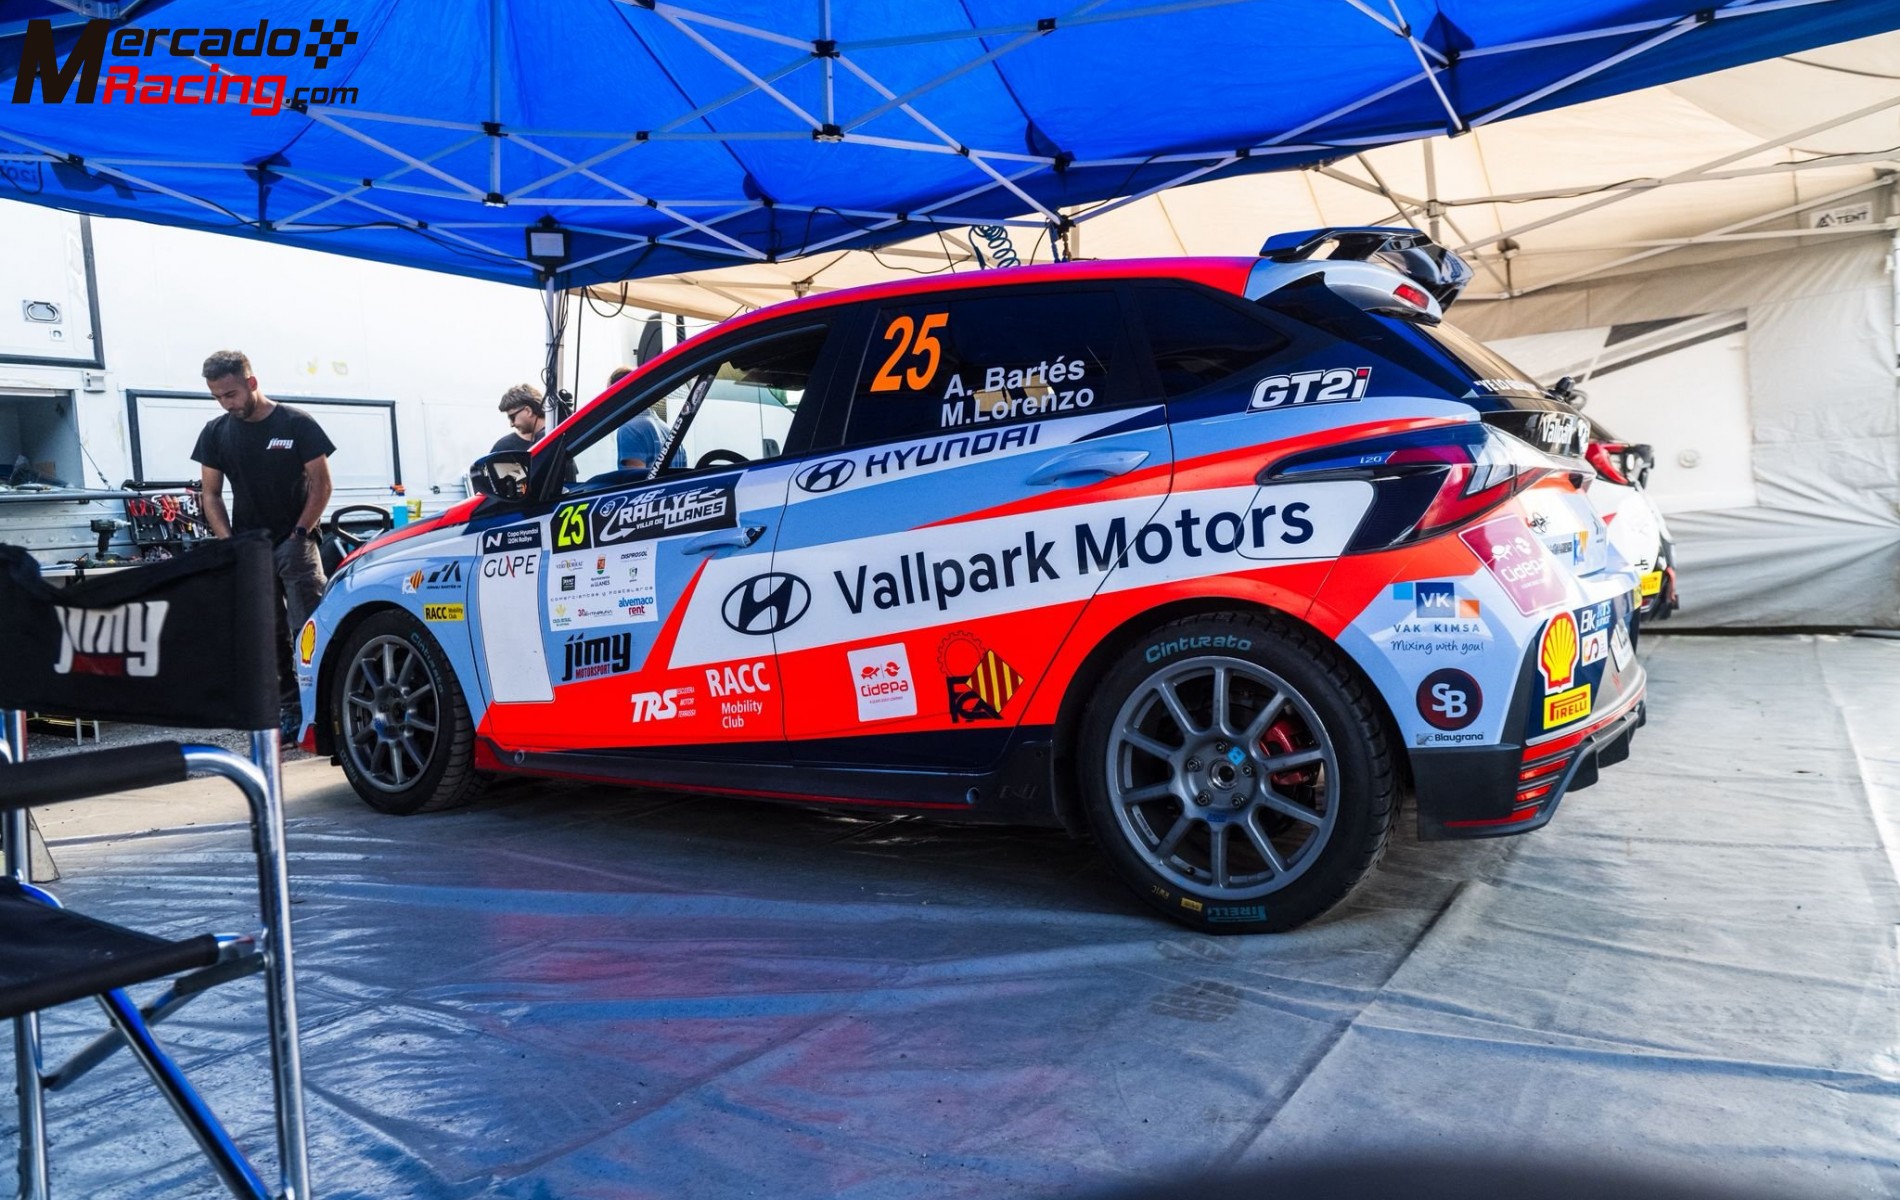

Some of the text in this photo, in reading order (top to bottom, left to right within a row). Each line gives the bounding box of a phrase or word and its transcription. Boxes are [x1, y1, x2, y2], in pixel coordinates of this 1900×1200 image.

[870, 312, 949, 392] 25
[944, 356, 1085, 400] A. Bartés
[1251, 367, 1369, 409] GT2i
[940, 388, 1095, 428] M.Lorenzo
[266, 438, 293, 450] jimy
[865, 424, 1041, 478] HYUNDAI
[618, 490, 702, 526] RALLYE
[668, 500, 723, 525] LLANES
[557, 503, 590, 547] 25
[636, 517, 664, 530] VILLA DE
[834, 502, 1315, 615] Vallpark Motors
[425, 606, 447, 620] RACC
[618, 596, 653, 608] alvemaco
[628, 605, 645, 615] rent
[1420, 592, 1450, 608] VK
[54, 600, 170, 677] jimy
[1393, 623, 1480, 633] VAK KIMSA
[562, 632, 632, 682] jimy
[1144, 634, 1252, 664] Cinturato
[1391, 639, 1484, 656] Mixing with you!
[575, 664, 610, 679] MOTORSPORT
[705, 661, 772, 697] RACC
[631, 688, 677, 723] TRS
[721, 699, 763, 715] Mobility
[1431, 682, 1468, 719] SB
[1550, 691, 1588, 721] PIRELLI
[722, 716, 744, 729] Club
[1434, 733, 1484, 743] Blaugrana
[1206, 906, 1268, 923] PIRELLI
